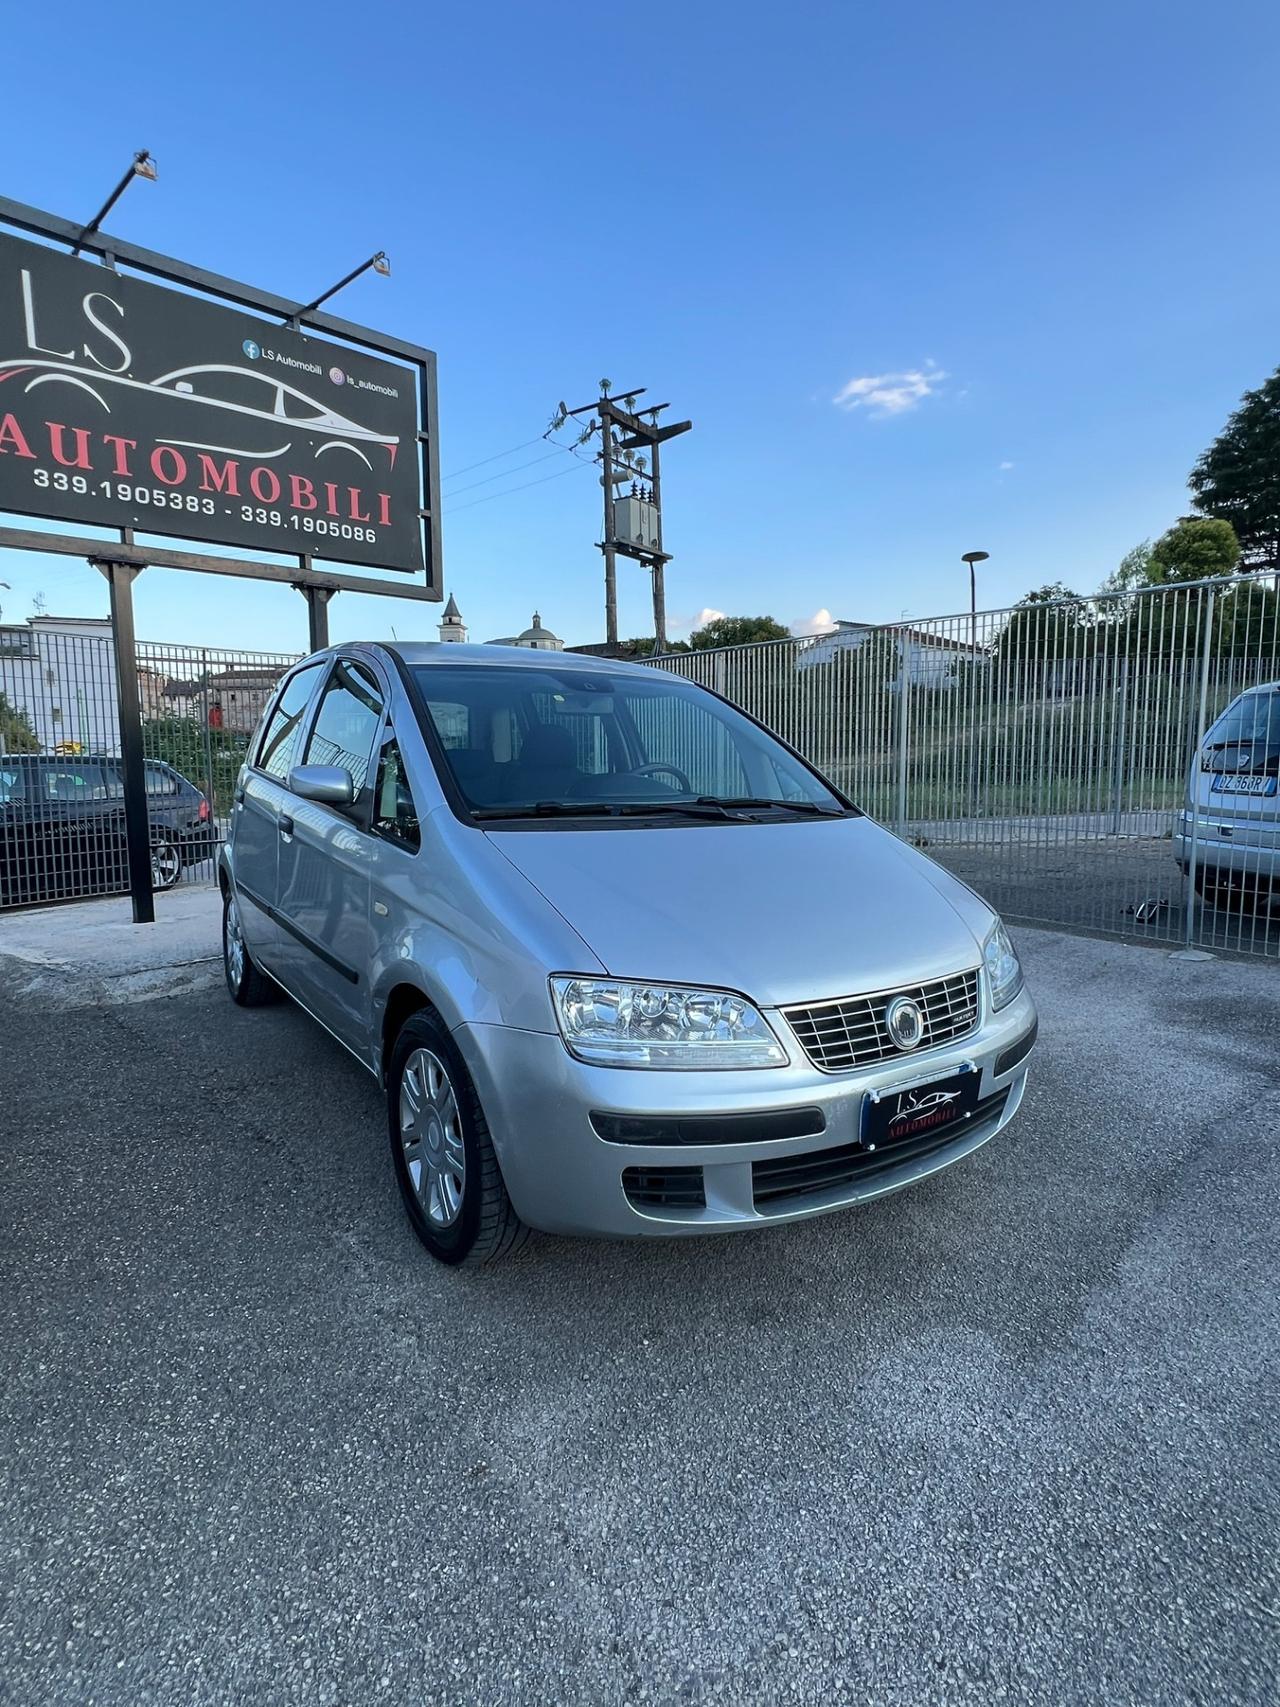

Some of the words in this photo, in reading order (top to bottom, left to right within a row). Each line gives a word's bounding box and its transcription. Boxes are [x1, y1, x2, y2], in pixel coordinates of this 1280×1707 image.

[21, 269, 132, 372] LS
[261, 347, 275, 361] LS
[276, 353, 322, 375] Automobili
[347, 374, 398, 398] ls_automobili
[0, 412, 392, 526] AUTOMOBILI
[33, 468, 216, 515] 339.1905383
[241, 505, 377, 544] 339.1905086
